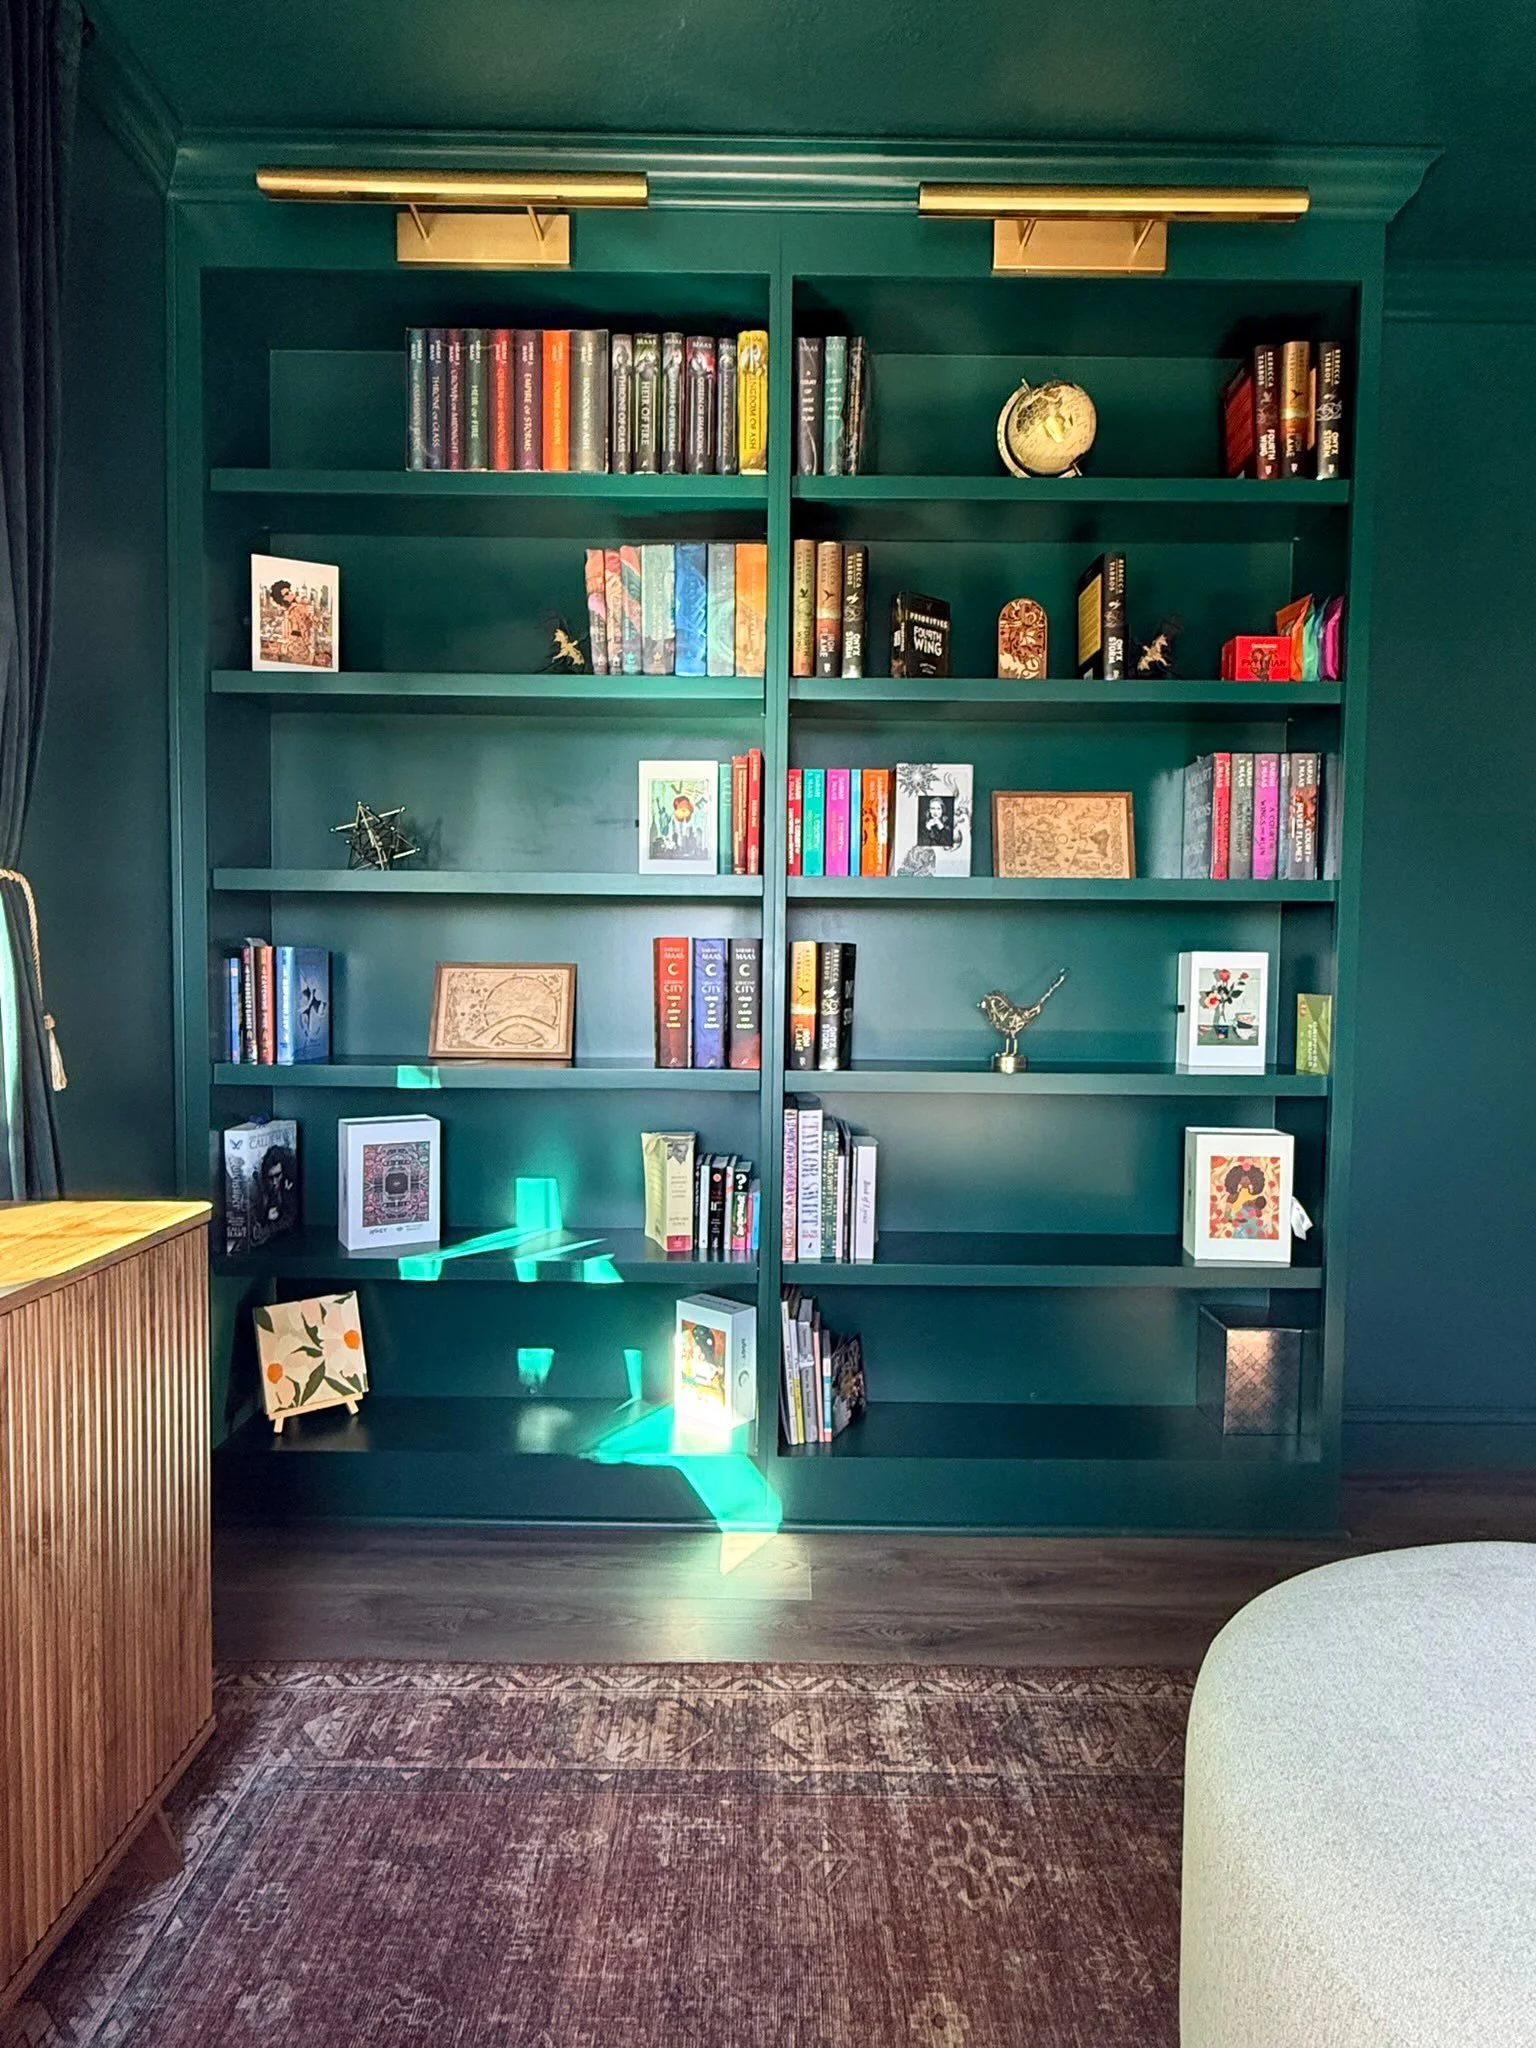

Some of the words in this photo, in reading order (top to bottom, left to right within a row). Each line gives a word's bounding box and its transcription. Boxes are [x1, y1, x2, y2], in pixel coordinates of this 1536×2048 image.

[1324, 352, 1332, 384] YARROS
[431, 376, 440, 409] THRONE
[470, 384, 480, 406] HEIR
[523, 372, 532, 403] EMPIRE
[617, 374, 627, 412] THRONE
[641, 381, 650, 406] HEIR
[641, 407, 650, 423] OF
[749, 418, 757, 430] OF
[470, 420, 480, 439] FIRE
[523, 416, 532, 452] STORMS
[617, 425, 627, 453] GLASS
[641, 423, 650, 446] FIRE
[749, 431, 757, 450] ASH
[1259, 434, 1268, 457] WING
[1267, 429, 1276, 460] FOURTH
[1323, 429, 1332, 458] STORM
[1331, 431, 1340, 455] ONYX
[1108, 561, 1116, 592] YARROS
[845, 631, 853, 659] STORM
[853, 633, 861, 656] ONYX
[913, 625, 943, 643] FOURTH
[913, 637, 943, 657] WING
[1108, 636, 1116, 664] STORM
[1115, 639, 1123, 661] ONYX
[1306, 759, 1314, 785] SARAH
[1295, 802, 1304, 829] SILVER
[1295, 830, 1304, 862] FLAMES
[1305, 828, 1313, 855] COURT
[702, 952, 722, 960] MAAS
[663, 985, 683, 993] CITY
[701, 985, 721, 993] CITY
[734, 985, 755, 993] CITY
[821, 1023, 830, 1051] STORM
[801, 1122, 819, 1178] TAYLOR
[826, 1148, 835, 1174] TAYLOR
[826, 1175, 835, 1195] SWIFT
[801, 1182, 819, 1227] SWIFT
[826, 1197, 835, 1216] STYLE
